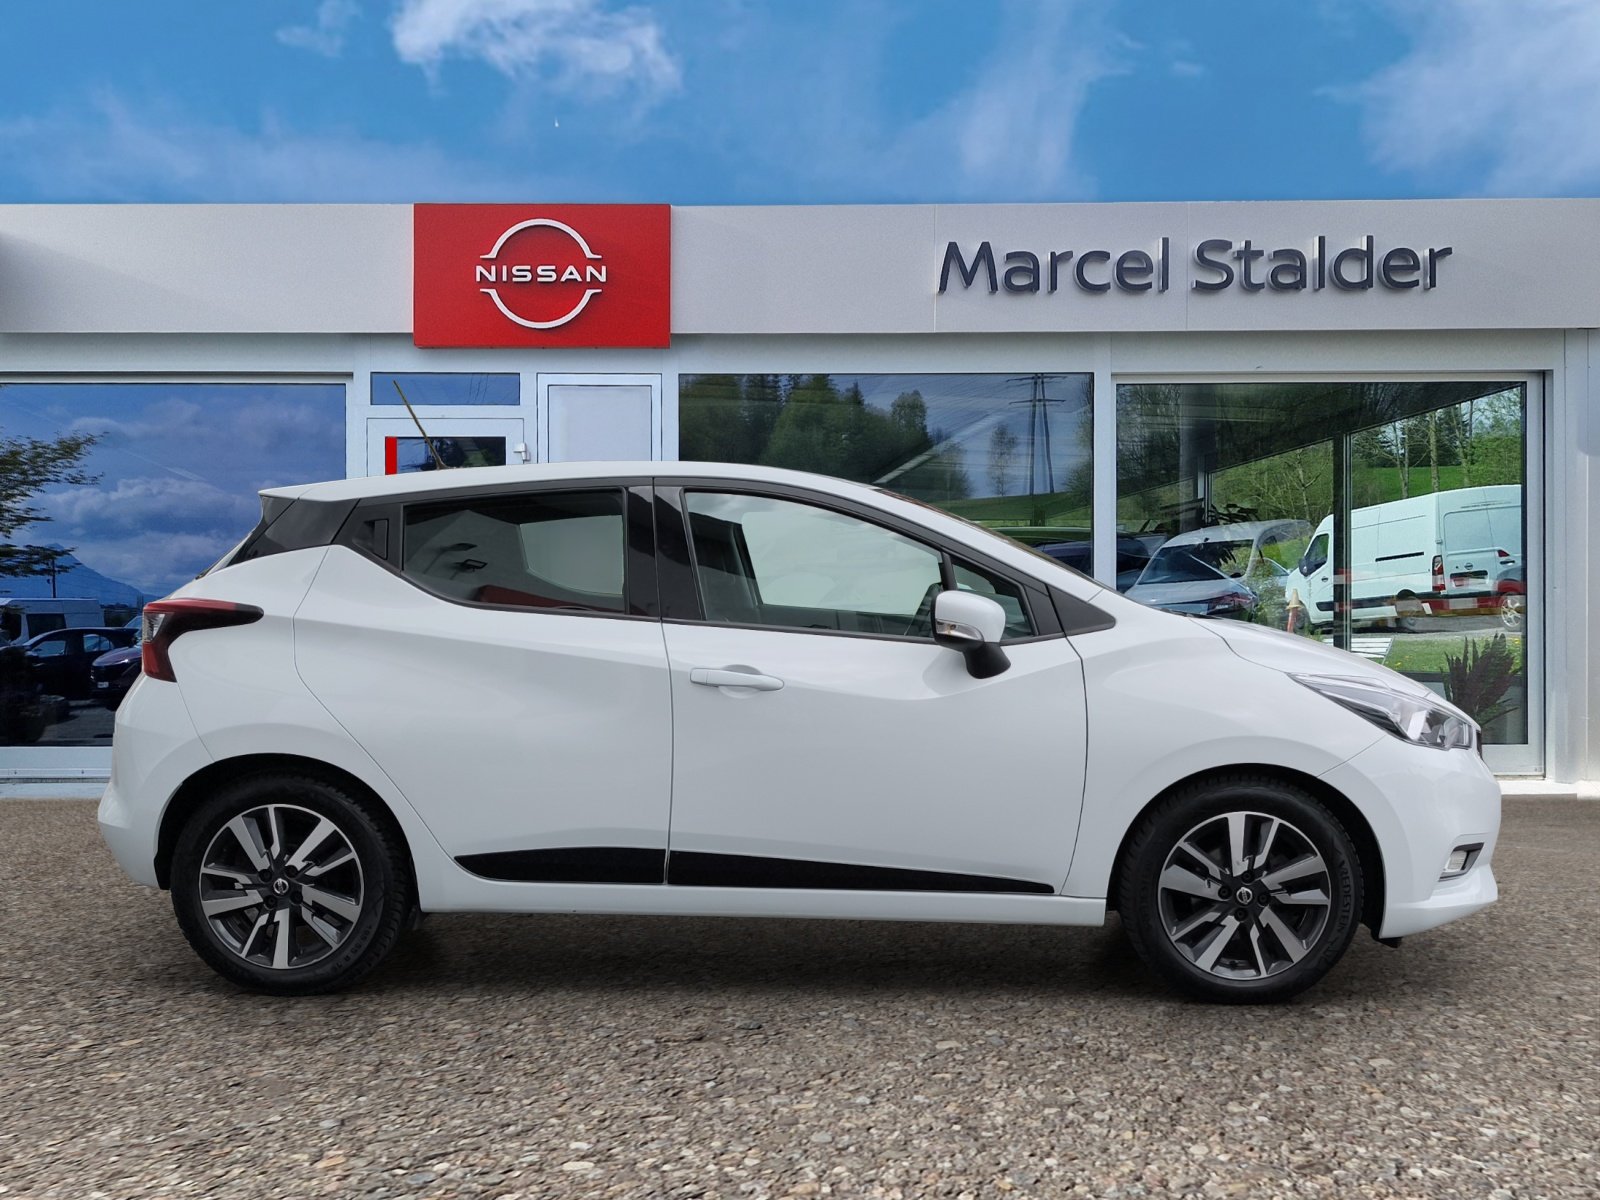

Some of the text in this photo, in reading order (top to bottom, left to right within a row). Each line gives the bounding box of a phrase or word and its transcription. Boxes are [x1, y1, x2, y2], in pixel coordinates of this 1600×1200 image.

[475, 265, 607, 283] NISSAN
[938, 235, 1453, 294] Marcel Stalder
[1337, 859, 1352, 934] VREDESTEIN
